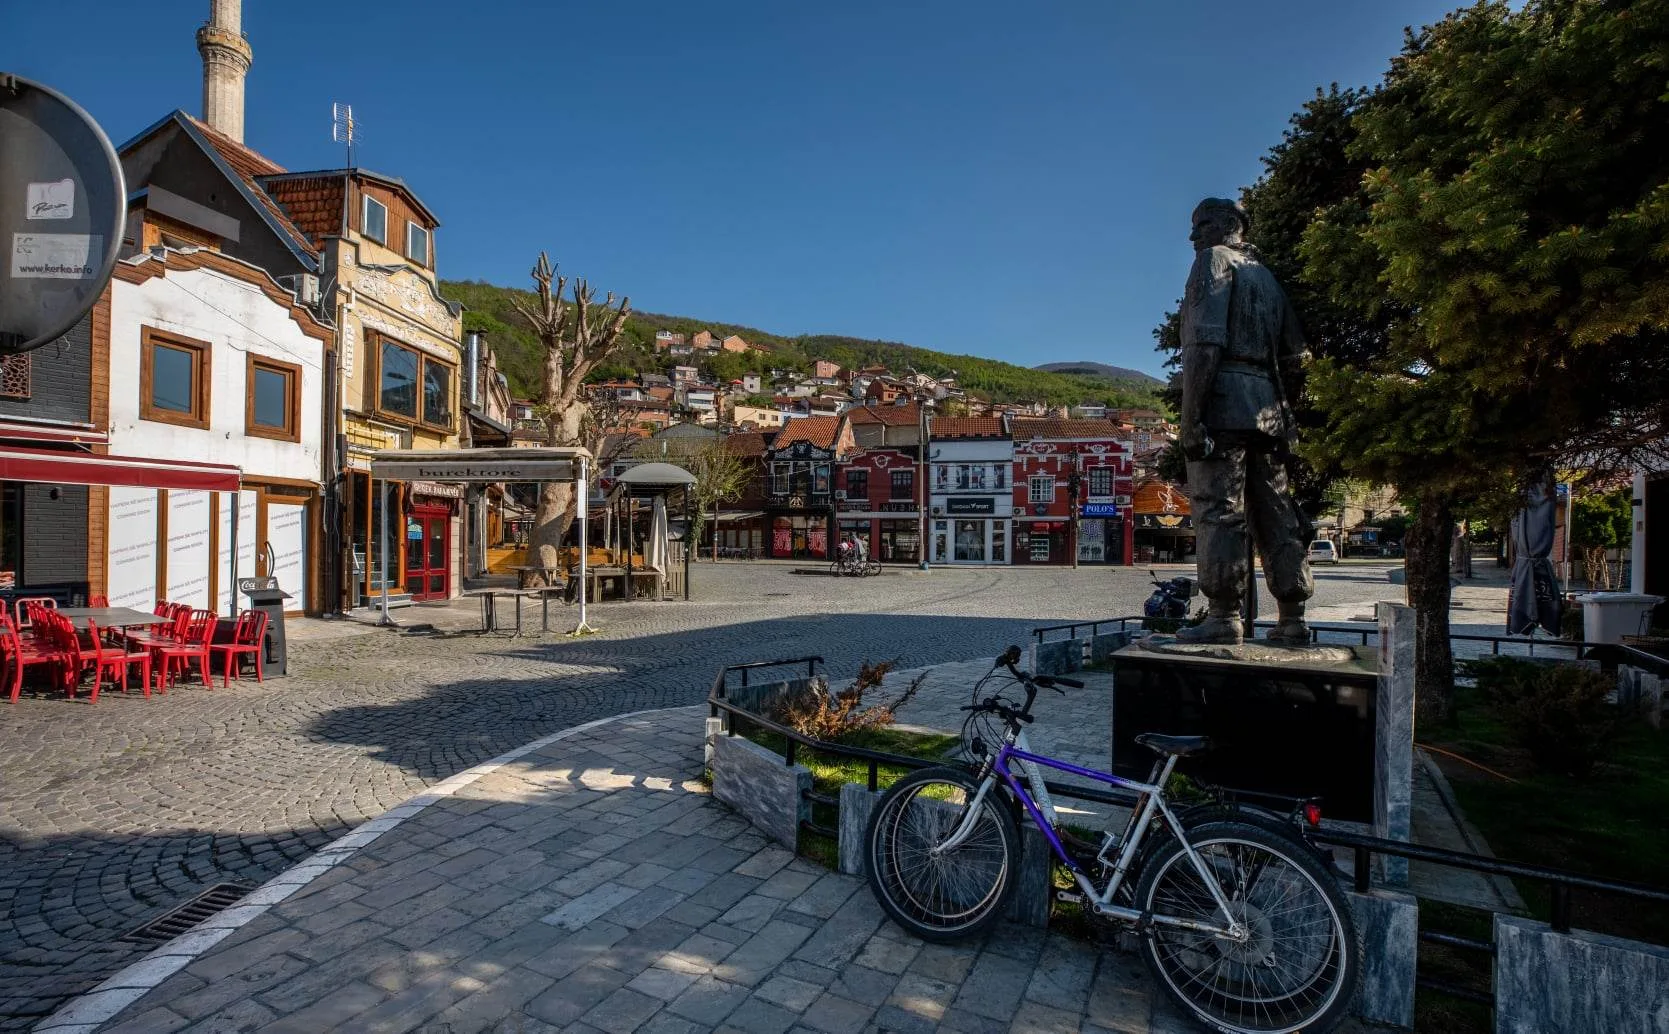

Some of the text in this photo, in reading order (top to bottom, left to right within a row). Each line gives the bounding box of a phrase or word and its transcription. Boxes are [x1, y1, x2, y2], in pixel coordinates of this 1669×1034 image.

[19, 263, 93, 275] www.kerko.info
[419, 468, 521, 477] burektore
[1086, 505, 1114, 513] POLO'S
